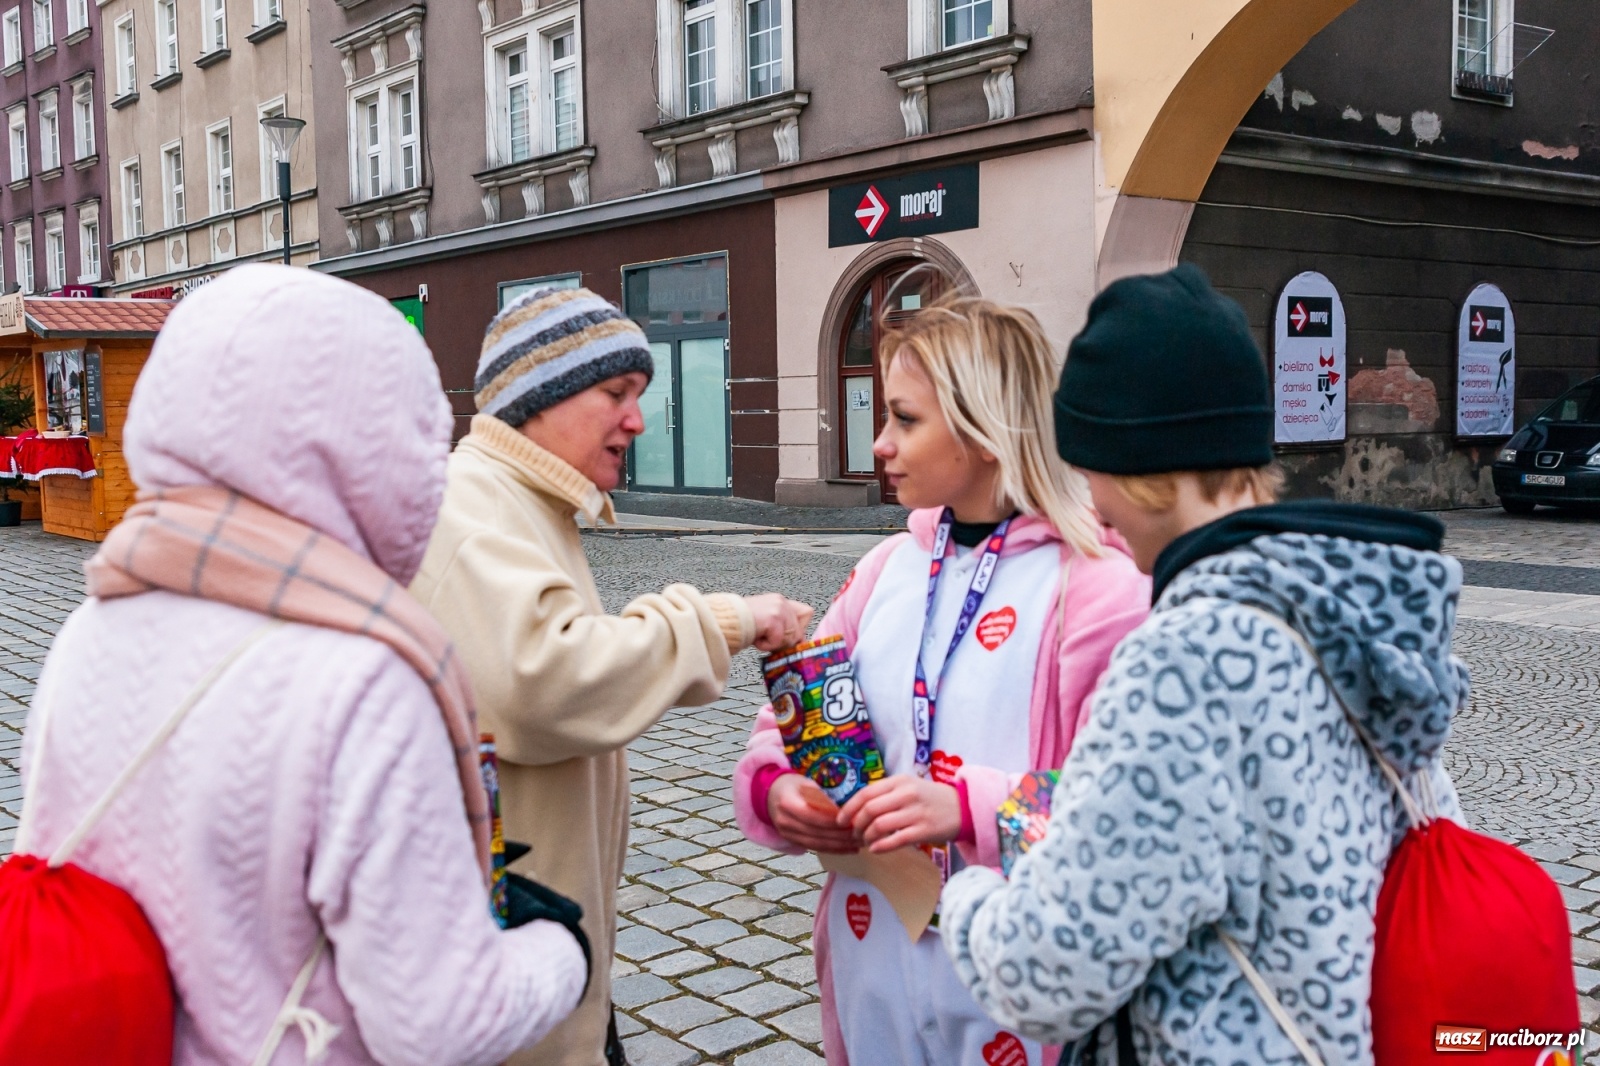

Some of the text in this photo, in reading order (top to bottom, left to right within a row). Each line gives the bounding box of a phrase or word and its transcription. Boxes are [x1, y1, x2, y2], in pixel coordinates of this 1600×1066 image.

[900, 182, 943, 217] moraj
[1283, 361, 1314, 372] bielizna
[1465, 363, 1490, 374] rajstopy
[1282, 382, 1312, 393] damska
[1464, 379, 1492, 390] skarpety
[1282, 398, 1307, 410] męska
[1282, 413, 1319, 425] dziecięca
[1526, 475, 1543, 484] SRC
[978, 556, 993, 588] PLAY
[917, 701, 926, 736] PLAY
